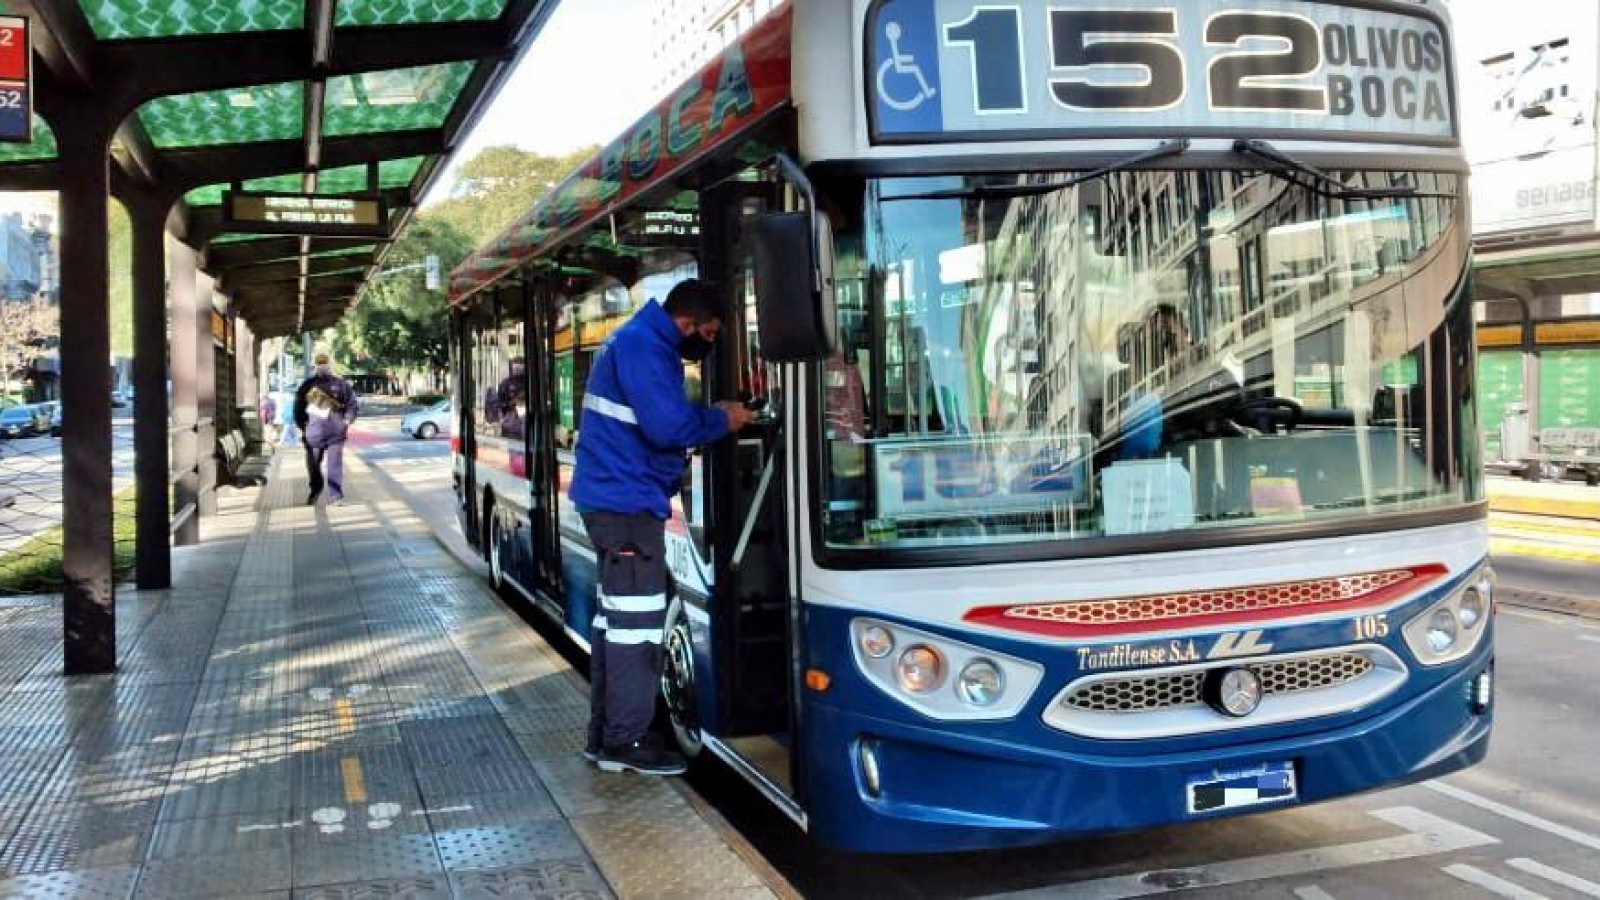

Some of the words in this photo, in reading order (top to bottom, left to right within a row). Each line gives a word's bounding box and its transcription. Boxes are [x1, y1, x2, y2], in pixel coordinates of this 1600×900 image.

[943, 4, 1327, 116] 152
[1323, 24, 1443, 72] OLIVOS
[1329, 75, 1446, 122] BOCA
[598, 42, 754, 204] BOCA
[1352, 614, 1388, 641] 105
[1077, 643, 1166, 670] Tandilense
